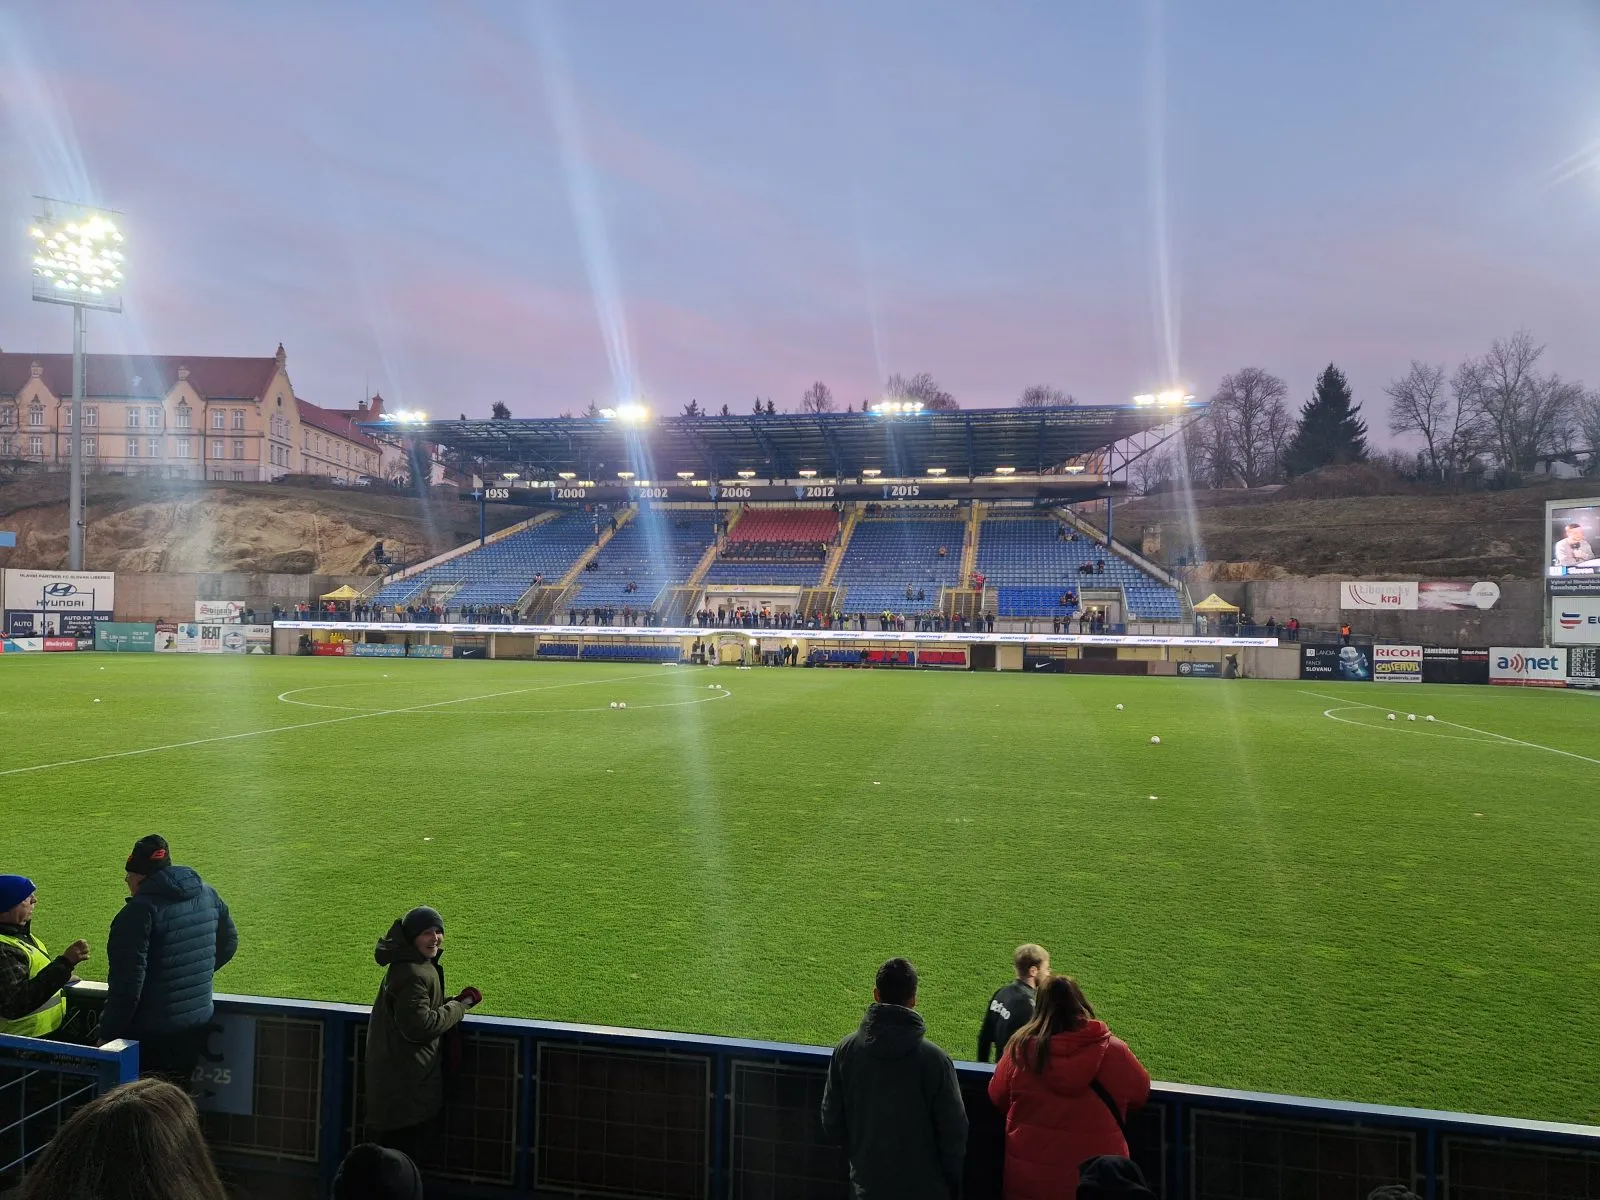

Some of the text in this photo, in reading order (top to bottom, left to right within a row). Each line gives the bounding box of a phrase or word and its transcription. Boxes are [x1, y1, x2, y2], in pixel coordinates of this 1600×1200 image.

[557, 488, 586, 498] 2000
[640, 488, 668, 498] 2002
[721, 488, 750, 498] 2006
[807, 487, 835, 497] 2012
[891, 485, 920, 496] 2015
[1381, 594, 1401, 605] kraj
[201, 626, 221, 639] BEAT
[1376, 649, 1420, 657] RICOH
